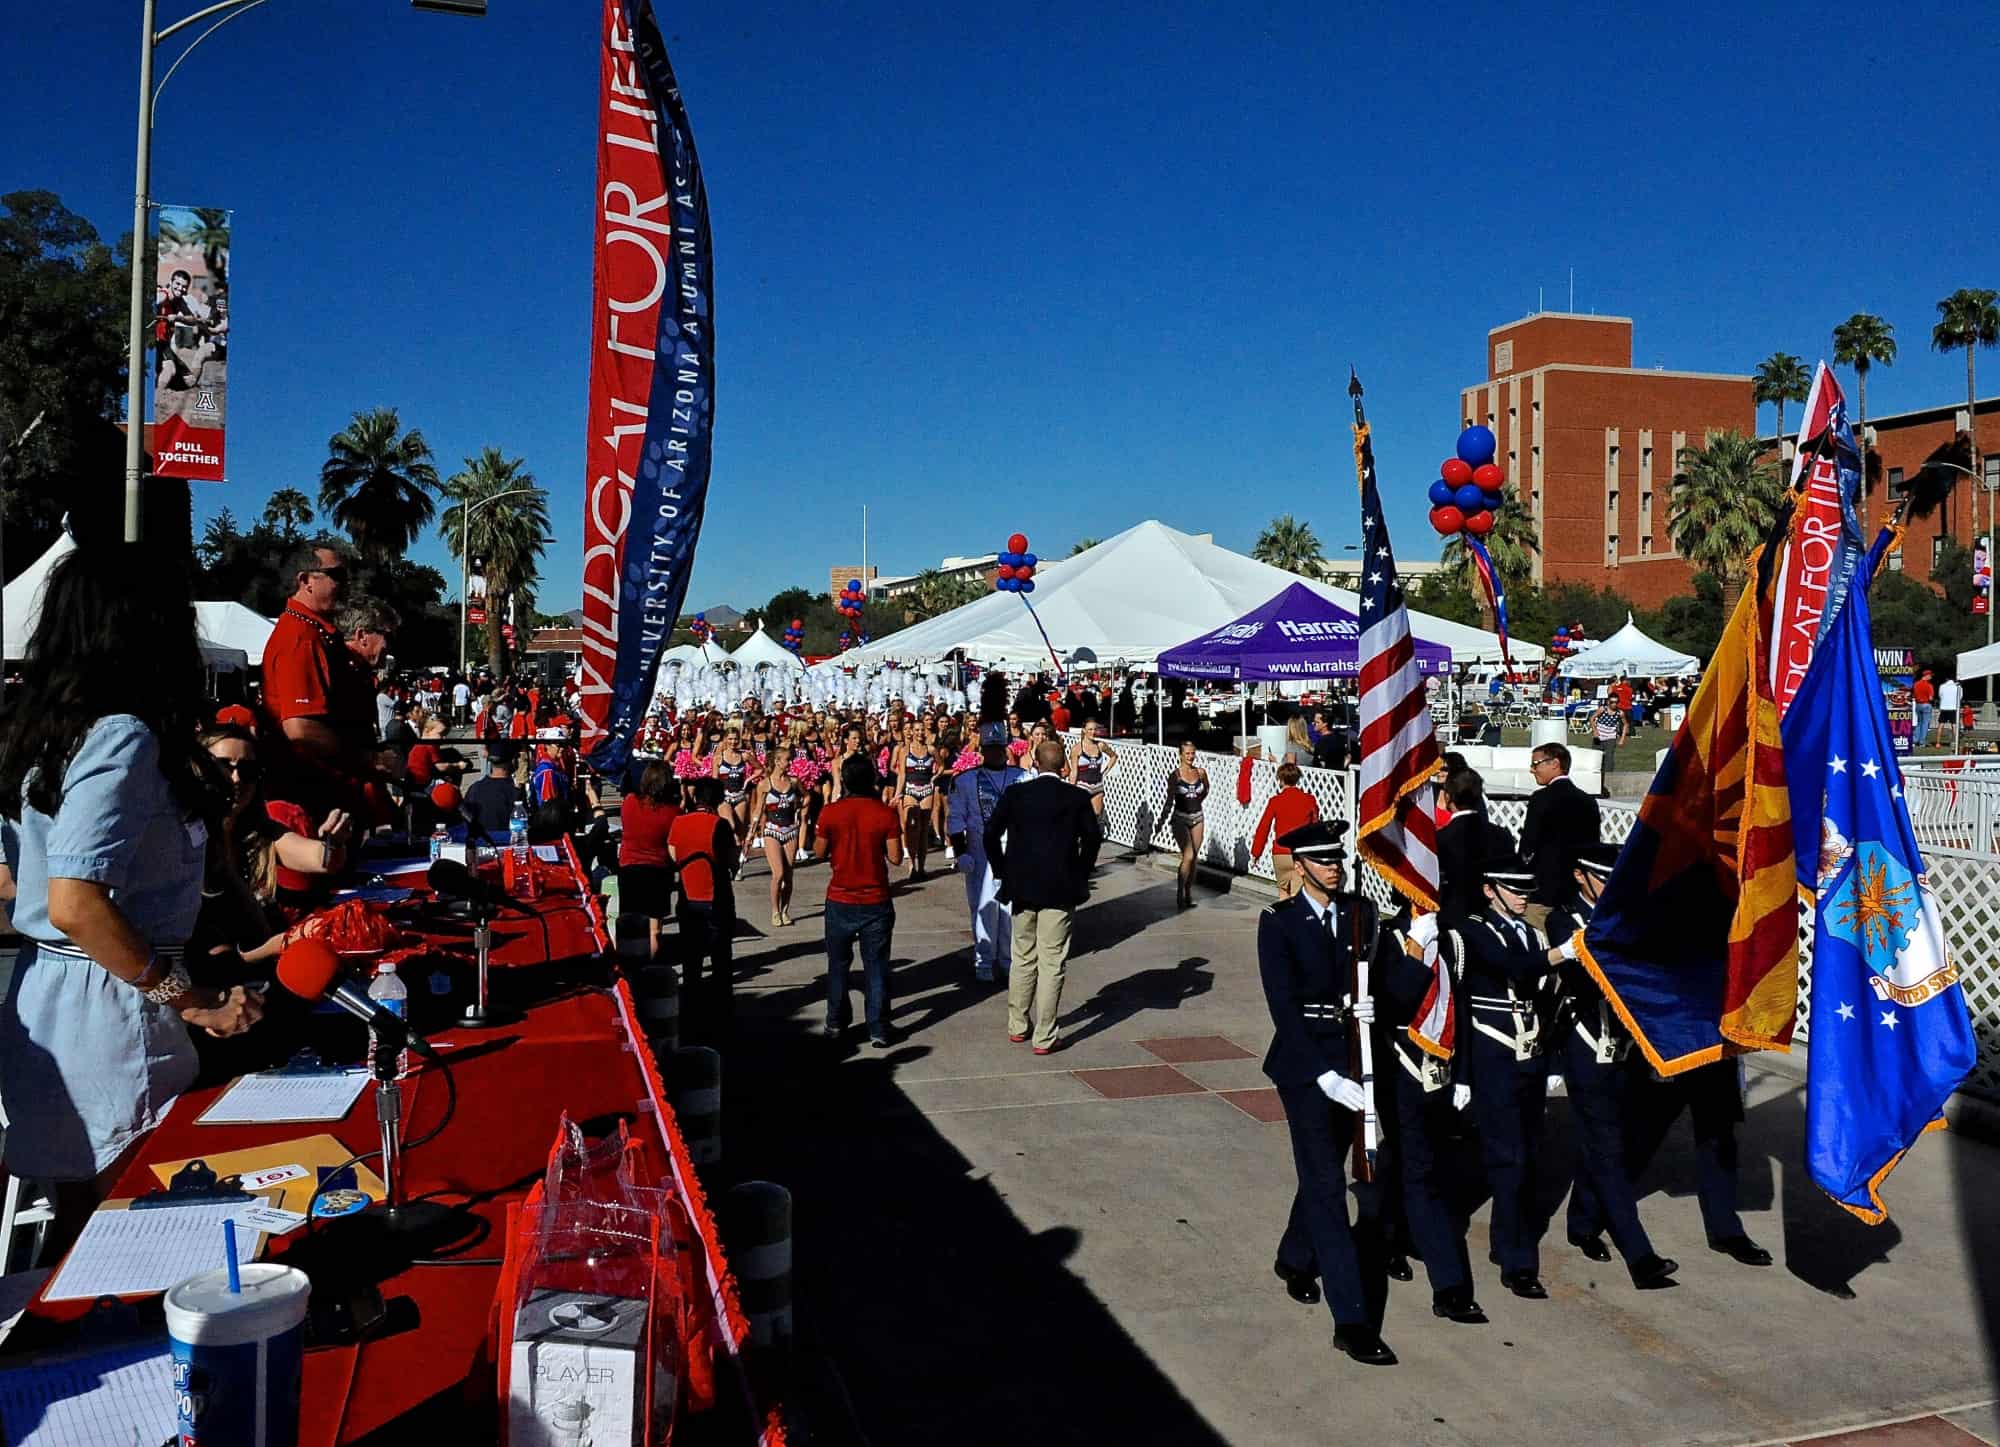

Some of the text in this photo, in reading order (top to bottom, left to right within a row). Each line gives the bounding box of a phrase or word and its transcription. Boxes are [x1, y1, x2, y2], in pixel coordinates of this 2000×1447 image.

[606, 7, 659, 154] LIFE
[604, 181, 671, 360] FOR
[175, 442, 203, 452] PULL
[639, 227, 701, 682] NIVERSITY OF ARIZONA ALUMNI
[158, 452, 219, 464] TOGETHER
[1802, 516, 1841, 592] FOR
[1289, 633, 1338, 643] AK-CHIN
[1878, 650, 1903, 666] WIN
[1887, 982, 1930, 1005] UNITED
[535, 1365, 615, 1384] PLAYER
